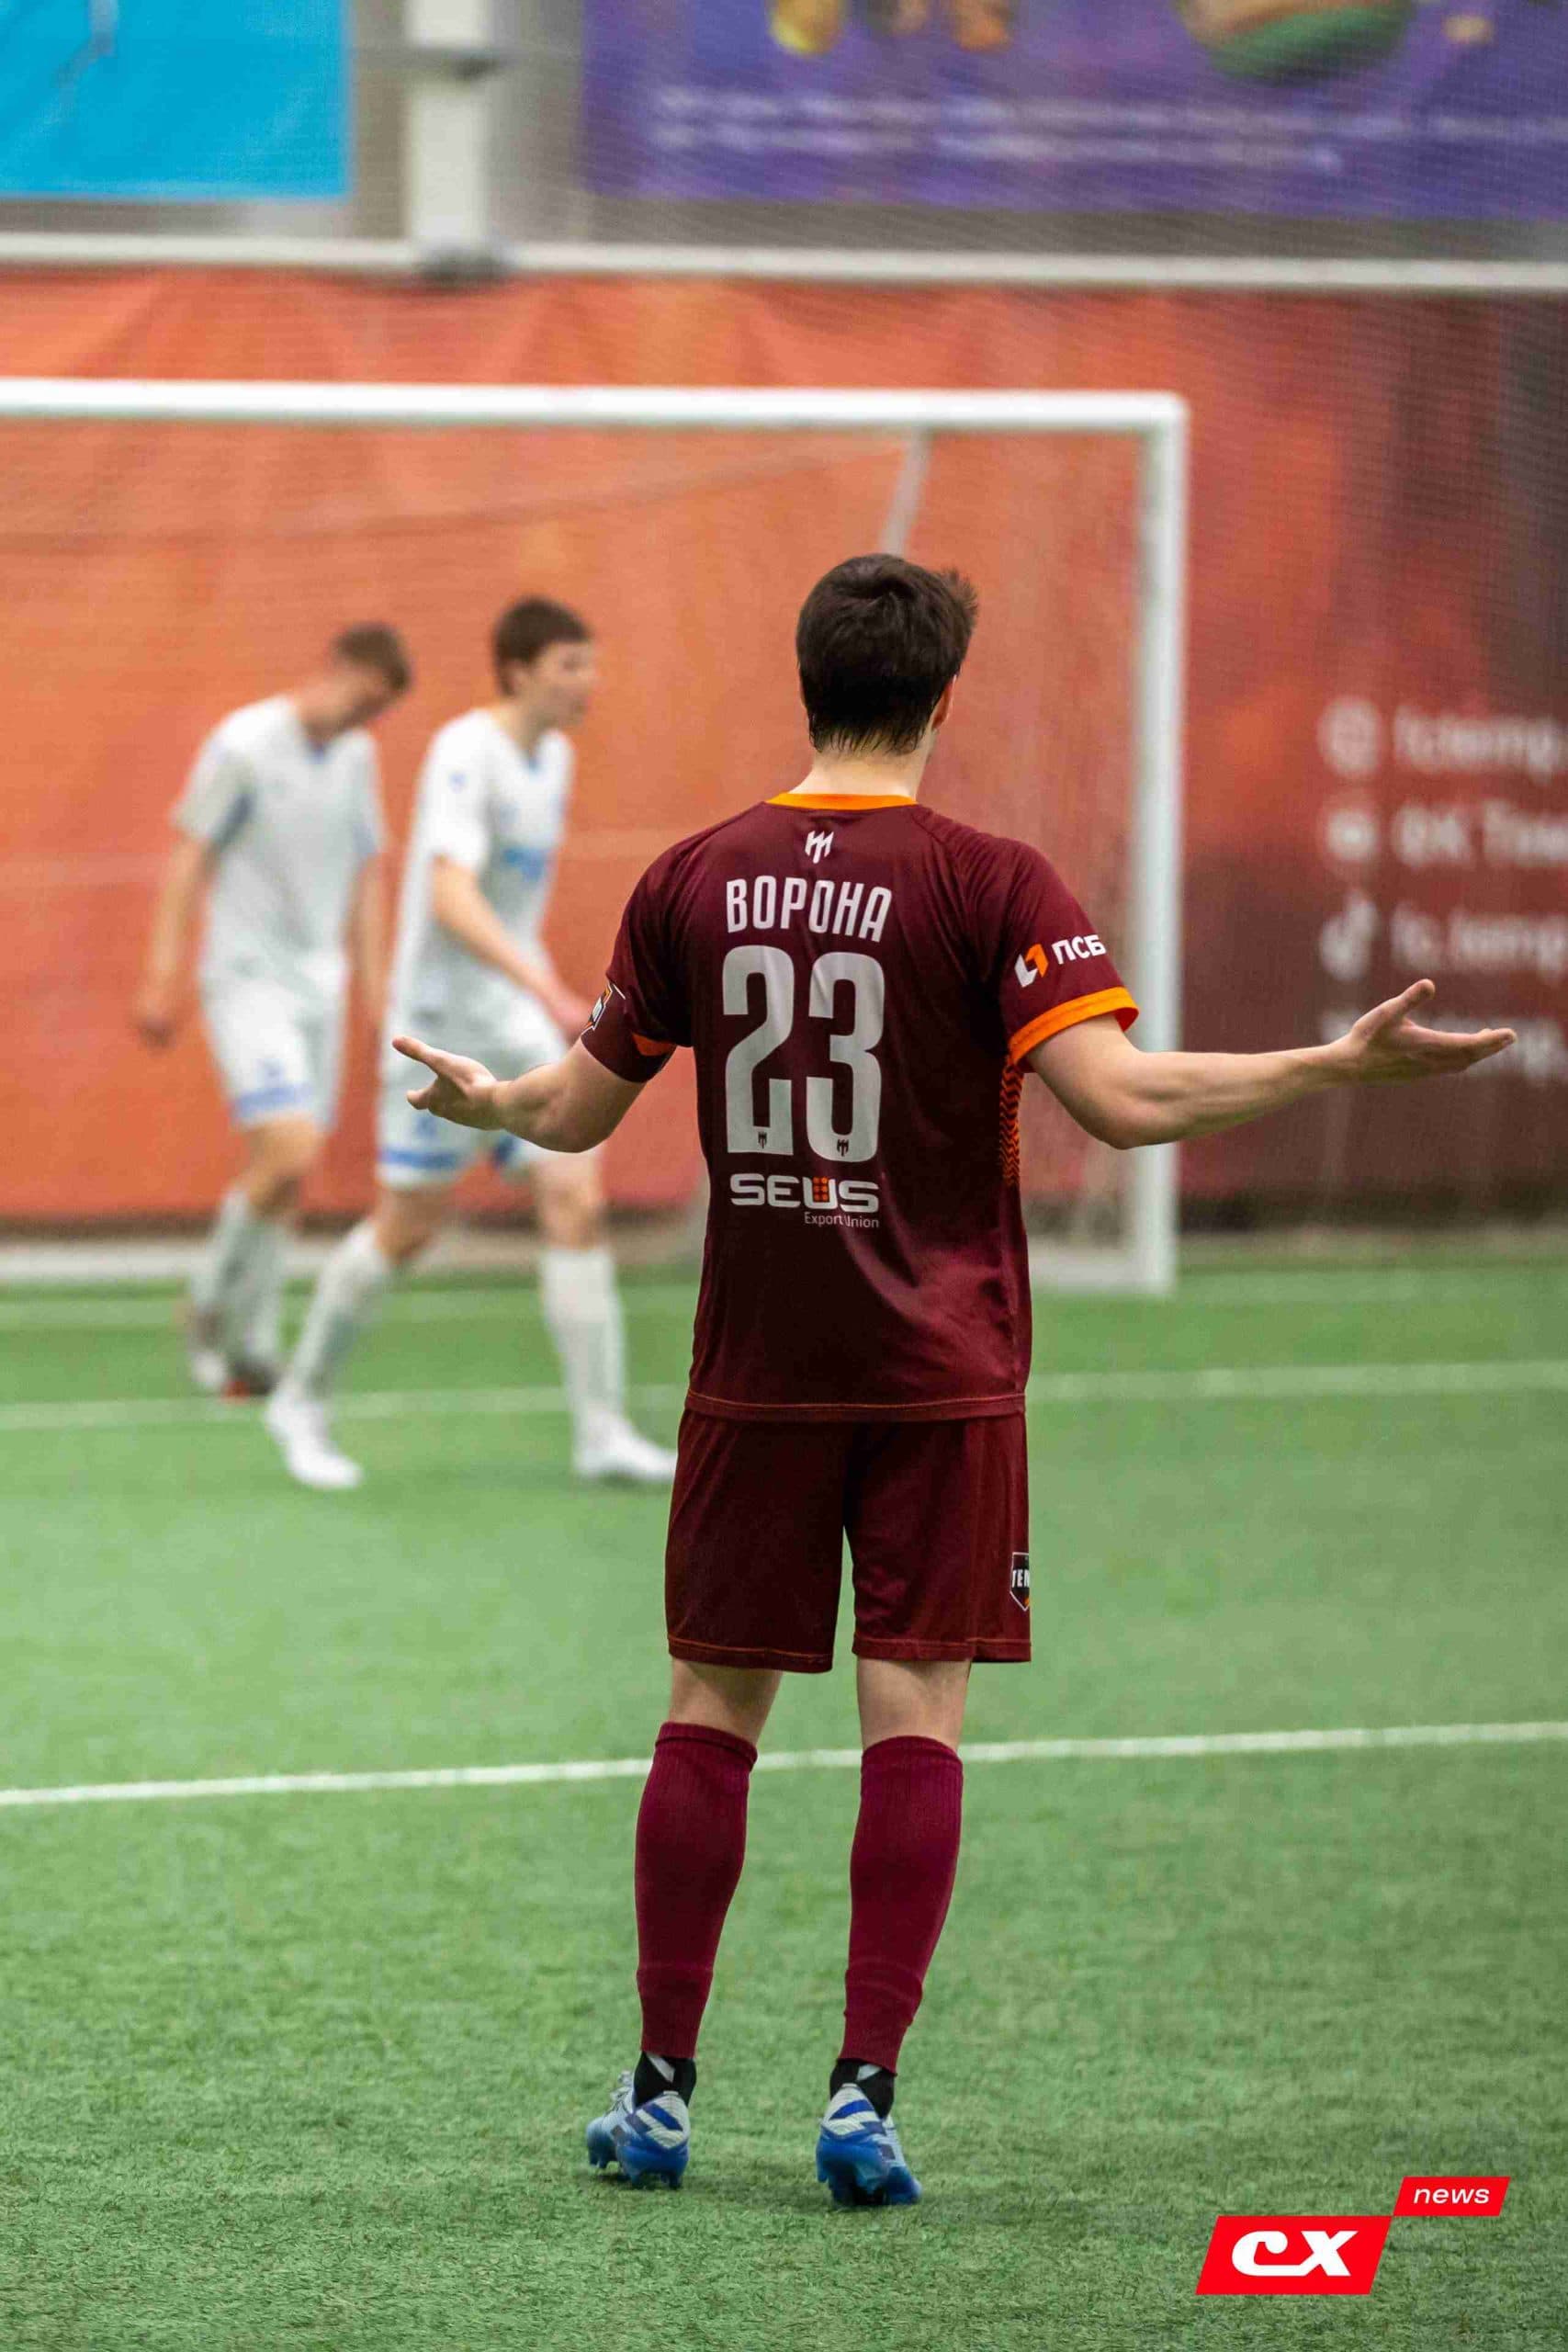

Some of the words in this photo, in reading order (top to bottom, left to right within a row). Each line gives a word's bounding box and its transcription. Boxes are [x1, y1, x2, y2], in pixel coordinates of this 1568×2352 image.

[726, 875, 893, 943] ВОРОНА
[1051, 934, 1107, 965] ПСБ
[722, 944, 886, 1163] 23
[730, 1172, 879, 1213] SEUS
